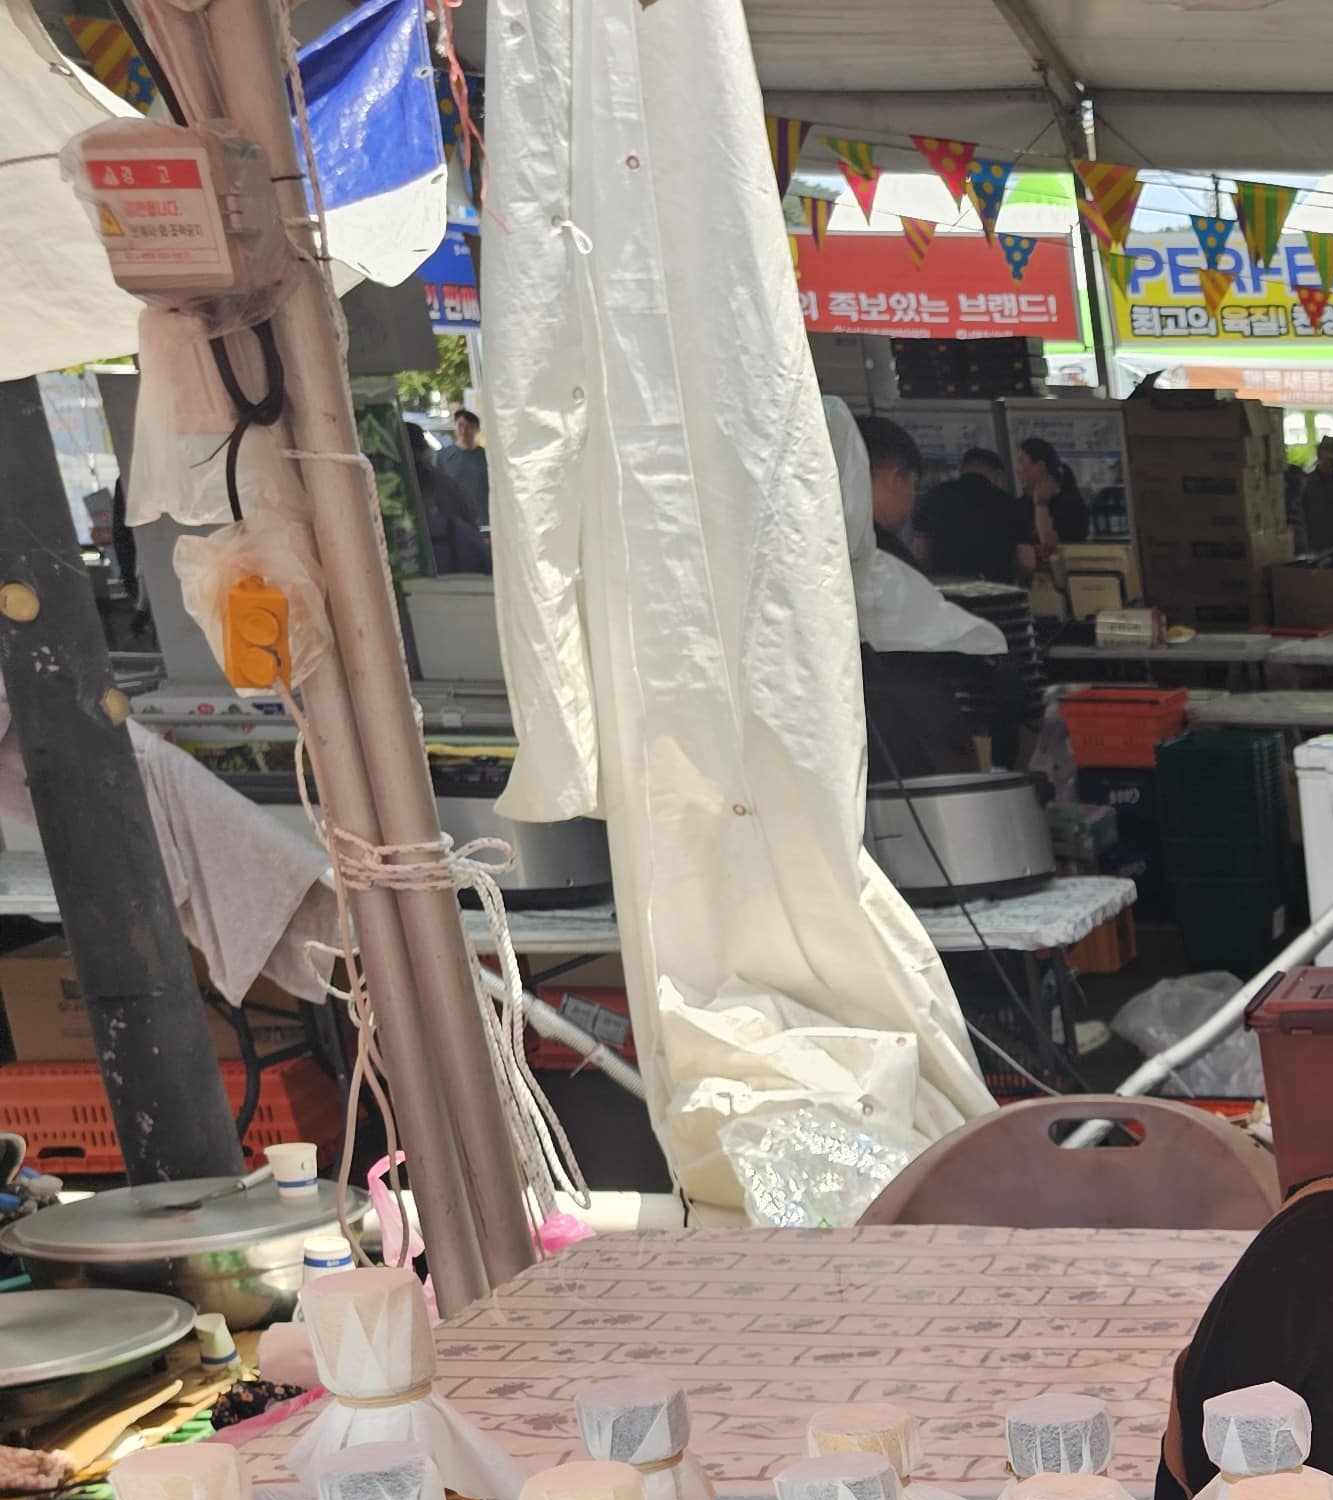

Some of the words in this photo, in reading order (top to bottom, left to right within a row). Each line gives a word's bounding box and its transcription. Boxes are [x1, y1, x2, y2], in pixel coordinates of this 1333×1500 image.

[828, 291, 949, 323] 족보있는
[958, 294, 1058, 323] 브랜드!
[1131, 304, 1217, 336] 최고의
